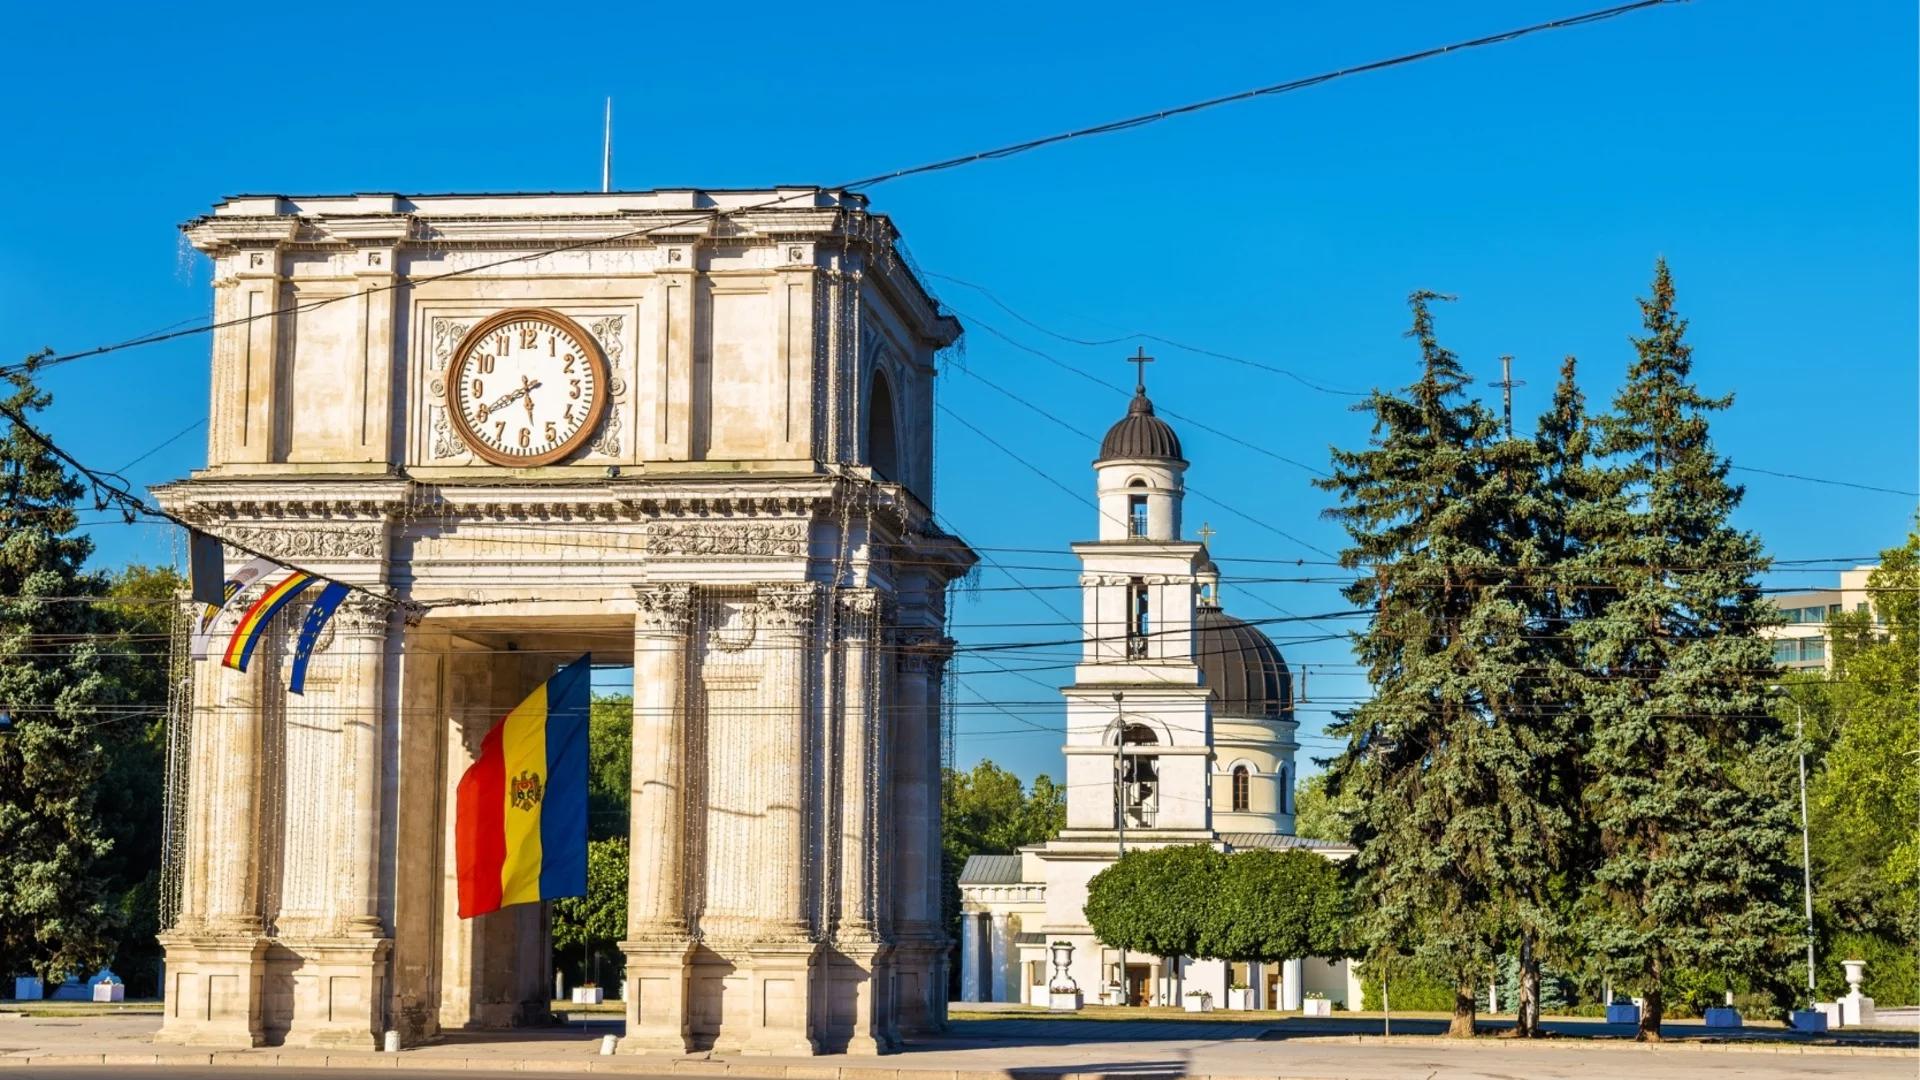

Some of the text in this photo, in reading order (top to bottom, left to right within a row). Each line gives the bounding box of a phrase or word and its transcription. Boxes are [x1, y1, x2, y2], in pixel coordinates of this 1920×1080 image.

[496, 335, 510, 356] 11
[519, 328, 538, 349] 12
[548, 336, 556, 357] 1
[476, 353, 495, 374] 10
[563, 353, 575, 374] 2
[471, 378, 483, 399] 9
[569, 379, 581, 400] 3
[476, 403, 489, 424] 8
[563, 404, 575, 424] 4
[495, 421, 507, 442] 7
[518, 427, 531, 448] 6
[545, 421, 557, 442] 5
